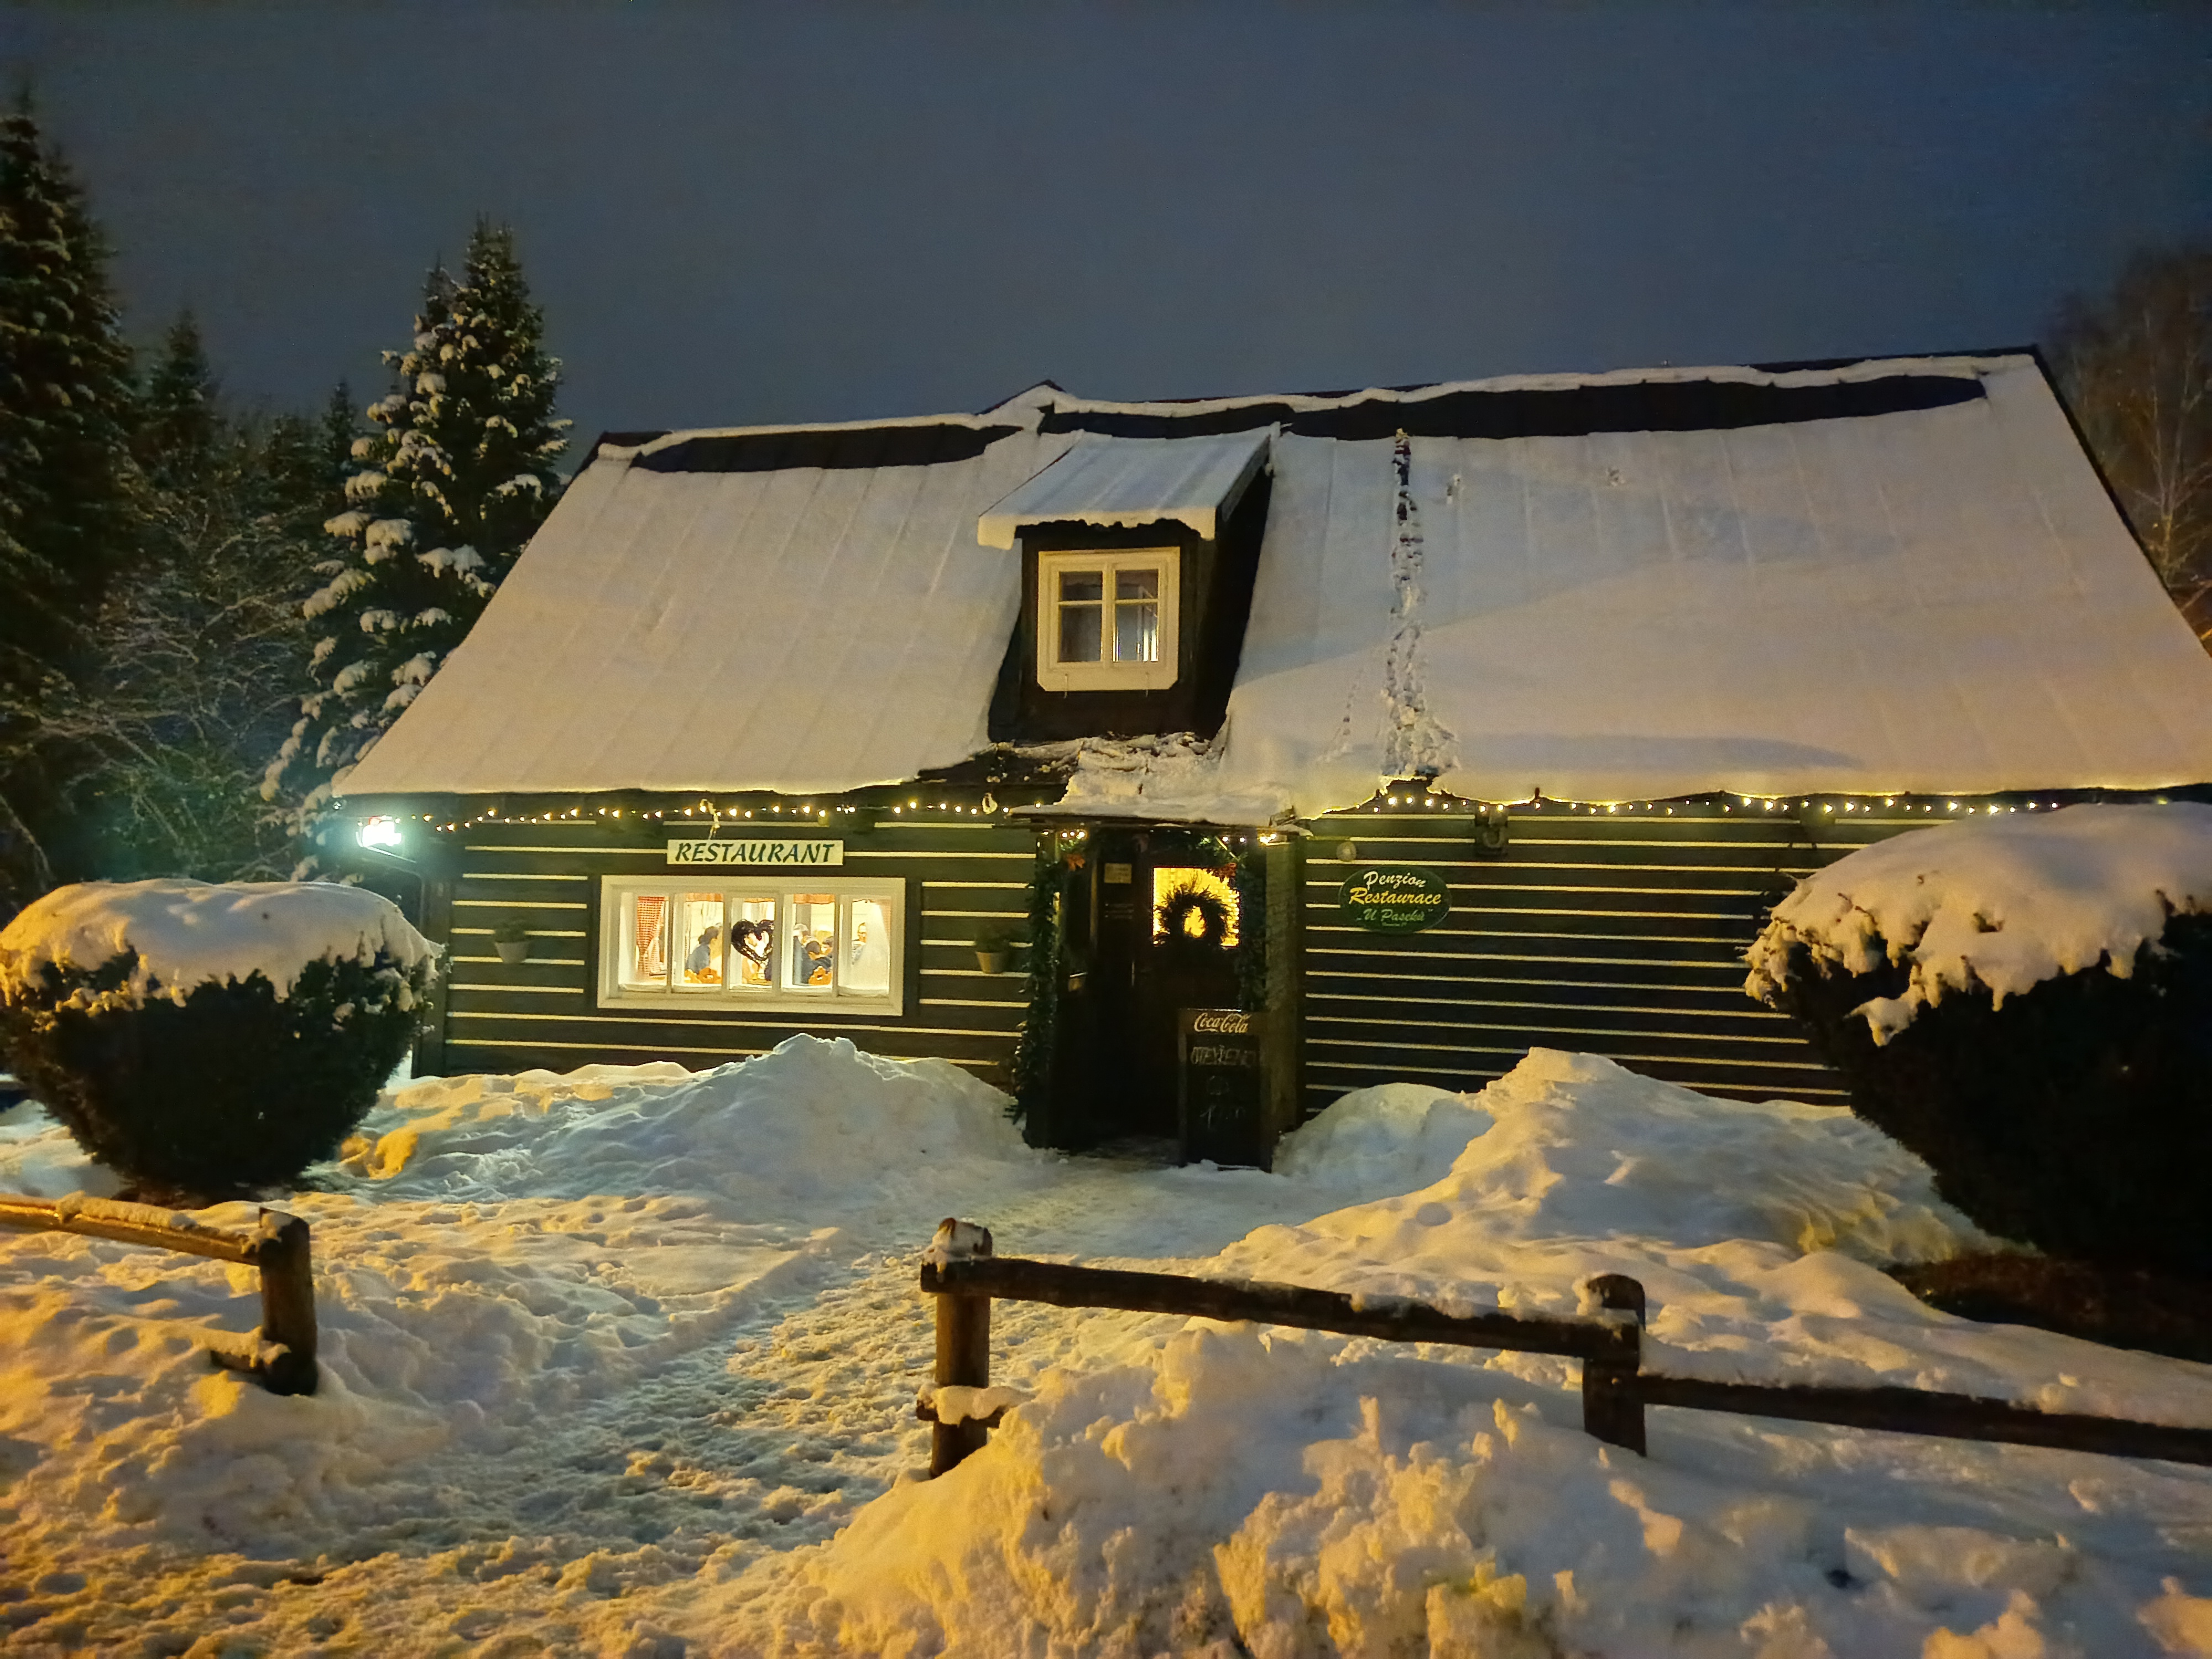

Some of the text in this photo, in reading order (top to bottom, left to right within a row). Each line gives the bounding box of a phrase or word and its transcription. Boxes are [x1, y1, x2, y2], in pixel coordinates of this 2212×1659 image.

[675, 843, 835, 863] RESTAURANT
[1363, 871, 1426, 890] Penzion
[1348, 887, 1442, 905] Restaurace
